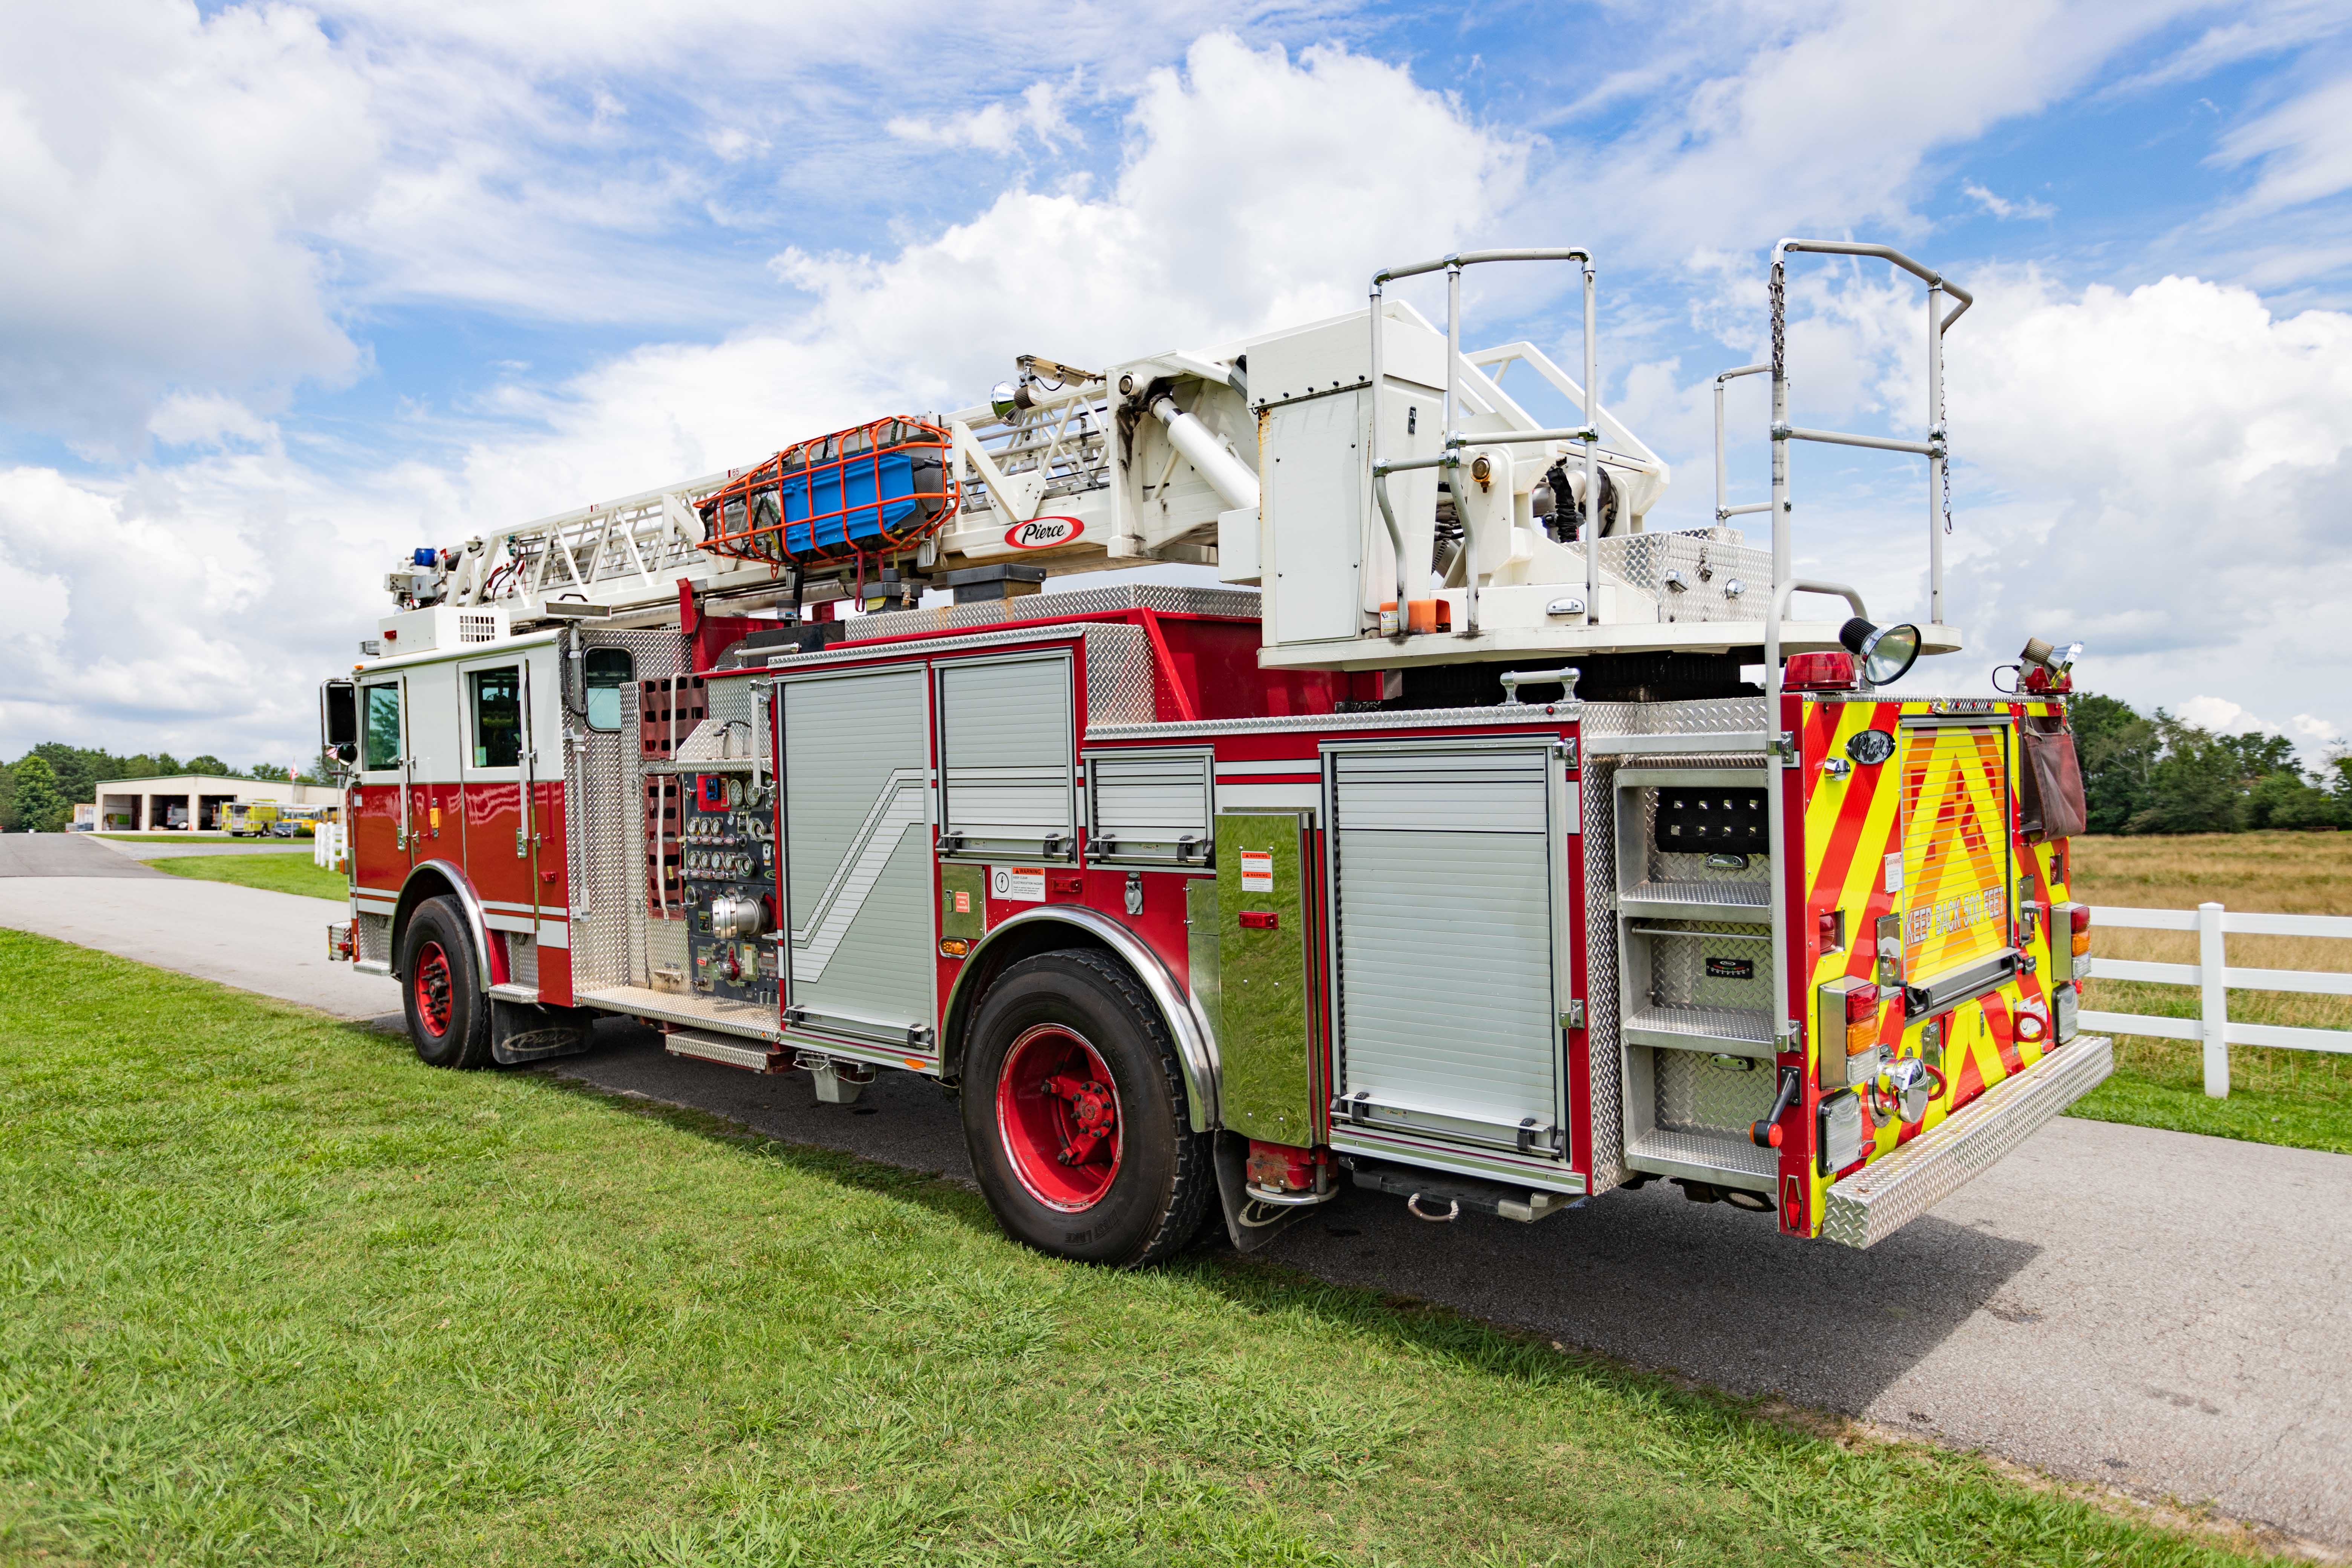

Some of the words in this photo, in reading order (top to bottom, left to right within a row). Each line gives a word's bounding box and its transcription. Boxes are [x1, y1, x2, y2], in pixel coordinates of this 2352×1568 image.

[732, 468, 739, 476] 65
[1022, 524, 1065, 544] Pierce
[1906, 907, 1932, 945] KEEP
[1936, 898, 1961, 936] BACK
[1964, 893, 1980, 927] 500
[1983, 886, 2004, 920] FEET
